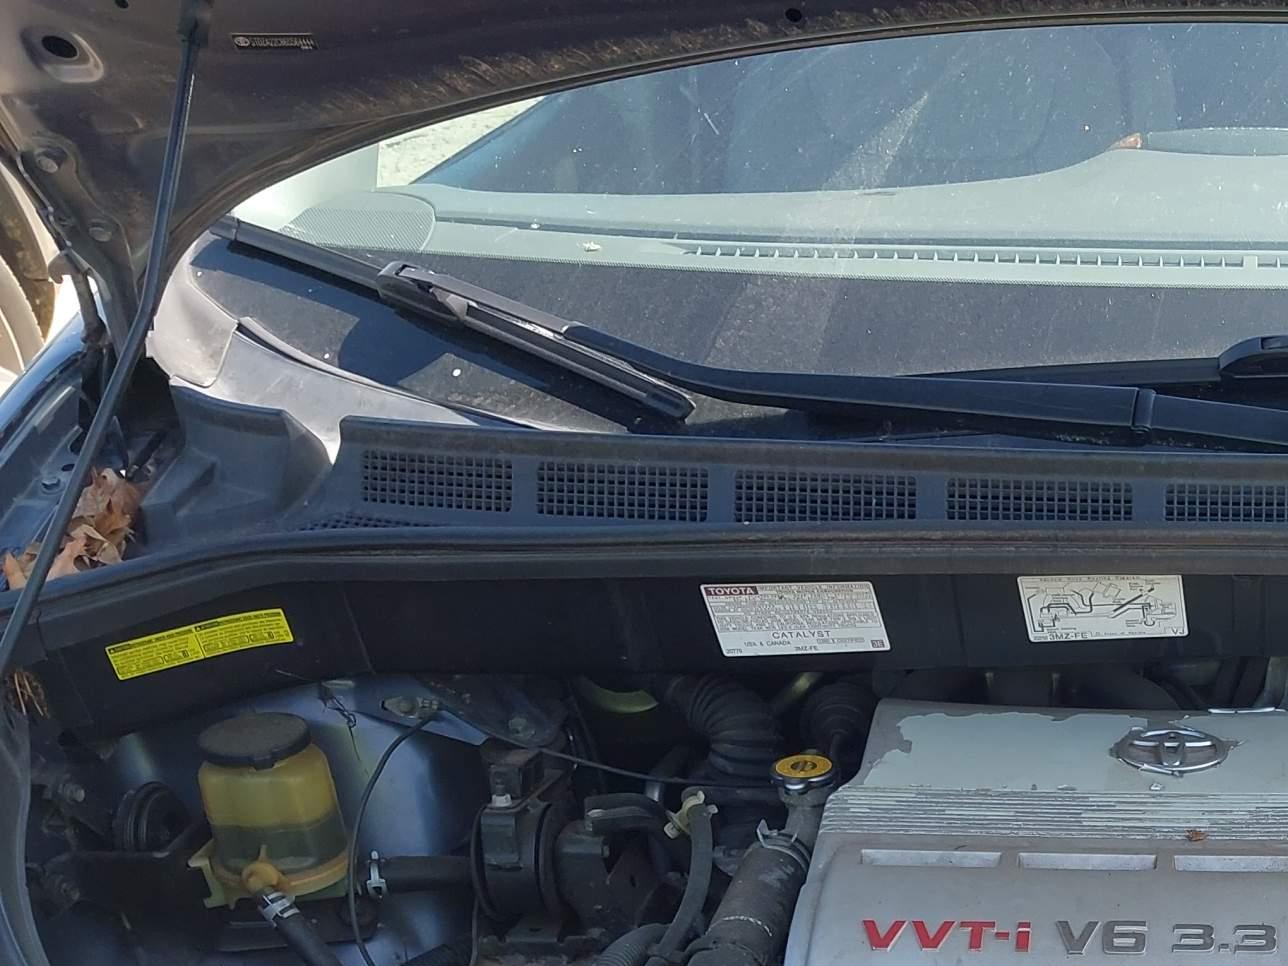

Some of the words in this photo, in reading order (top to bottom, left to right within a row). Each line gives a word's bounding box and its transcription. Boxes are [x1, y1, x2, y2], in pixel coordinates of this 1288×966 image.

[771, 630, 831, 640] CATALYST
[1048, 631, 1088, 641] 3MZ-FE
[862, 918, 1032, 953] VVT-i
[1055, 919, 1149, 956] V6
[1171, 922, 1280, 955] 3.3
